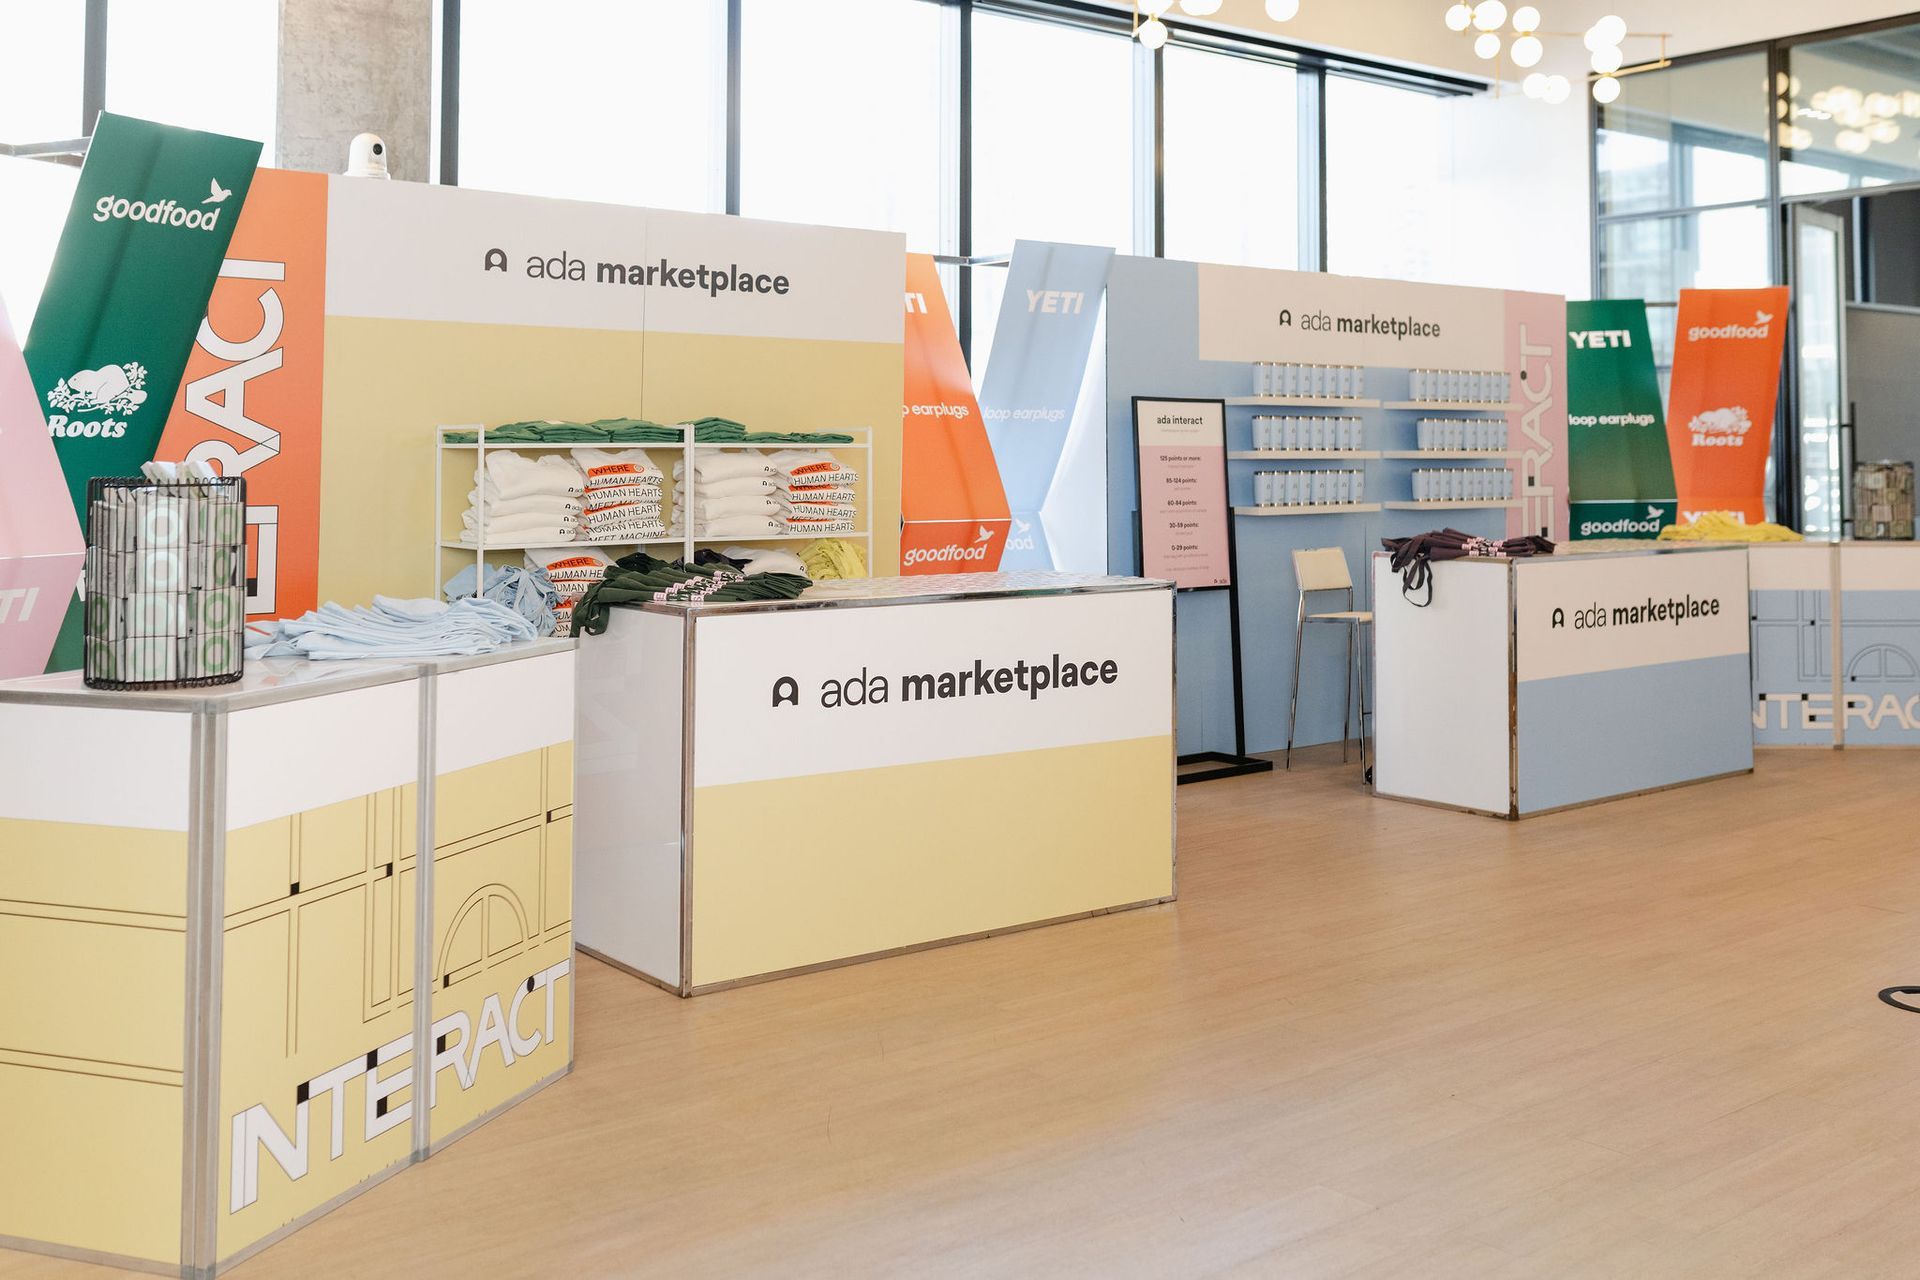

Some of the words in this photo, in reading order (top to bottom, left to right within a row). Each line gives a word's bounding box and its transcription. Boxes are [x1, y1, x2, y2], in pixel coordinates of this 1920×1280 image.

[93, 195, 221, 231] goodfood
[526, 250, 586, 281] ada
[596, 259, 790, 298] marketplace
[1027, 289, 1085, 315] YETI
[1301, 309, 1332, 331] ada
[1337, 313, 1441, 341] marketplace
[1688, 324, 1769, 342] goodfood
[1568, 330, 1632, 349] YETI
[912, 402, 970, 419] earplugs
[985, 405, 1010, 422] loop
[1012, 406, 1065, 423] earplugs
[48, 415, 128, 438] Roots
[1157, 415, 1171, 425] ada
[1172, 415, 1203, 425] interact
[1568, 413, 1597, 427] loop
[1599, 412, 1655, 427] earplugs
[1692, 433, 1744, 447] Roots
[592, 464, 630, 476] WHERE
[796, 464, 829, 475] WHERE
[590, 476, 627, 488] HUMAN
[628, 475, 664, 485] HEARTS
[794, 474, 827, 486] HUMAN
[828, 473, 860, 482] HEARTS
[587, 489, 627, 501] HUMAN
[628, 488, 663, 498] HEARTS
[791, 493, 825, 501] HUMAN
[826, 492, 856, 502] HEARTS
[587, 510, 626, 524] HUMAN
[627, 504, 662, 516] HEARTS
[793, 505, 825, 516] HUMAN
[826, 508, 857, 518] HEARTS
[586, 523, 627, 535] HUMAN
[627, 519, 665, 530] HEARTS
[790, 524, 823, 533] HUMAN
[824, 522, 856, 532] HEARTS
[1581, 518, 1661, 536] goodfood
[904, 543, 988, 566] goodfood
[553, 558, 590, 569] WHERE
[549, 570, 588, 580] HUMAN
[1574, 601, 1607, 629] ada
[1612, 594, 1720, 626] marketplace
[820, 666, 889, 709] ada
[901, 653, 1119, 700] marketplace
[230, 958, 571, 1215] INTERACT
